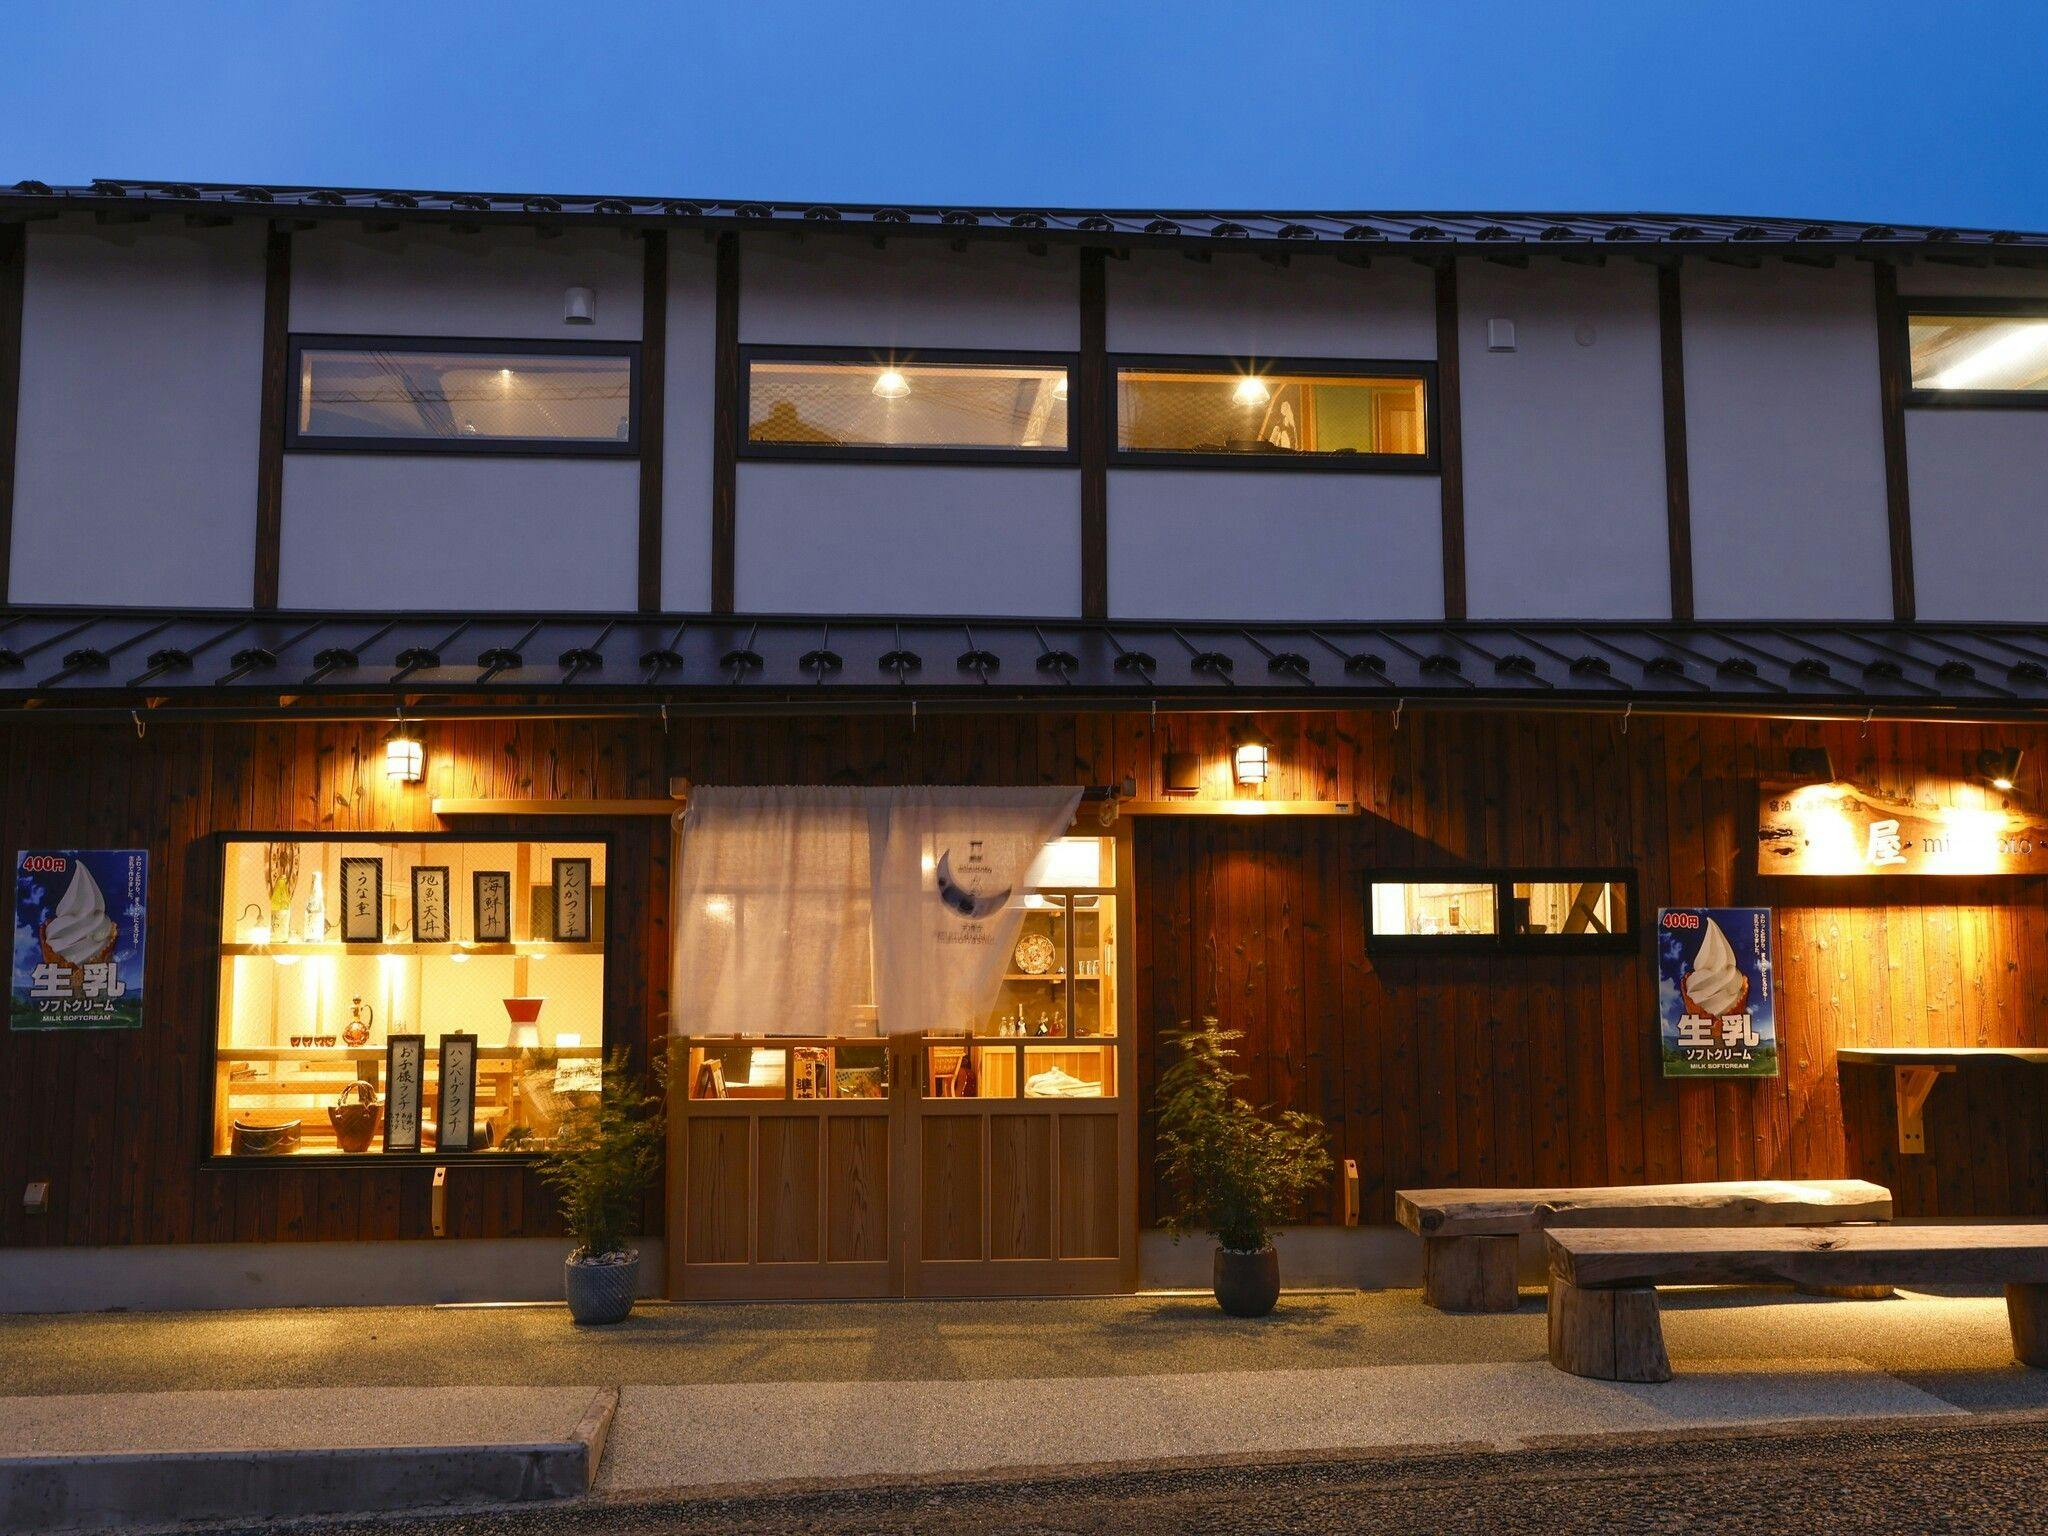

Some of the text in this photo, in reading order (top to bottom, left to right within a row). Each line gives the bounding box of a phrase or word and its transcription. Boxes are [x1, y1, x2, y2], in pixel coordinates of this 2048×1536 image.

[23, 856, 66, 872] 400円
[355, 871, 371, 918] うな重
[420, 874, 439, 935] 地魚天丼
[482, 877, 503, 936] 海鮮丼
[563, 866, 581, 937] とんかつランチ
[1662, 912, 1699, 929] 400円
[30, 961, 127, 999] 生乳
[39, 999, 116, 1014] ソフトクリーム
[42, 1014, 62, 1022] MILK
[1677, 1014, 1760, 1047] 生乳
[1686, 1048, 1752, 1061] ソフトクリーム
[396, 1047, 415, 1111] お子様ランチ
[448, 1048, 464, 1136] ハンバーグランチ
